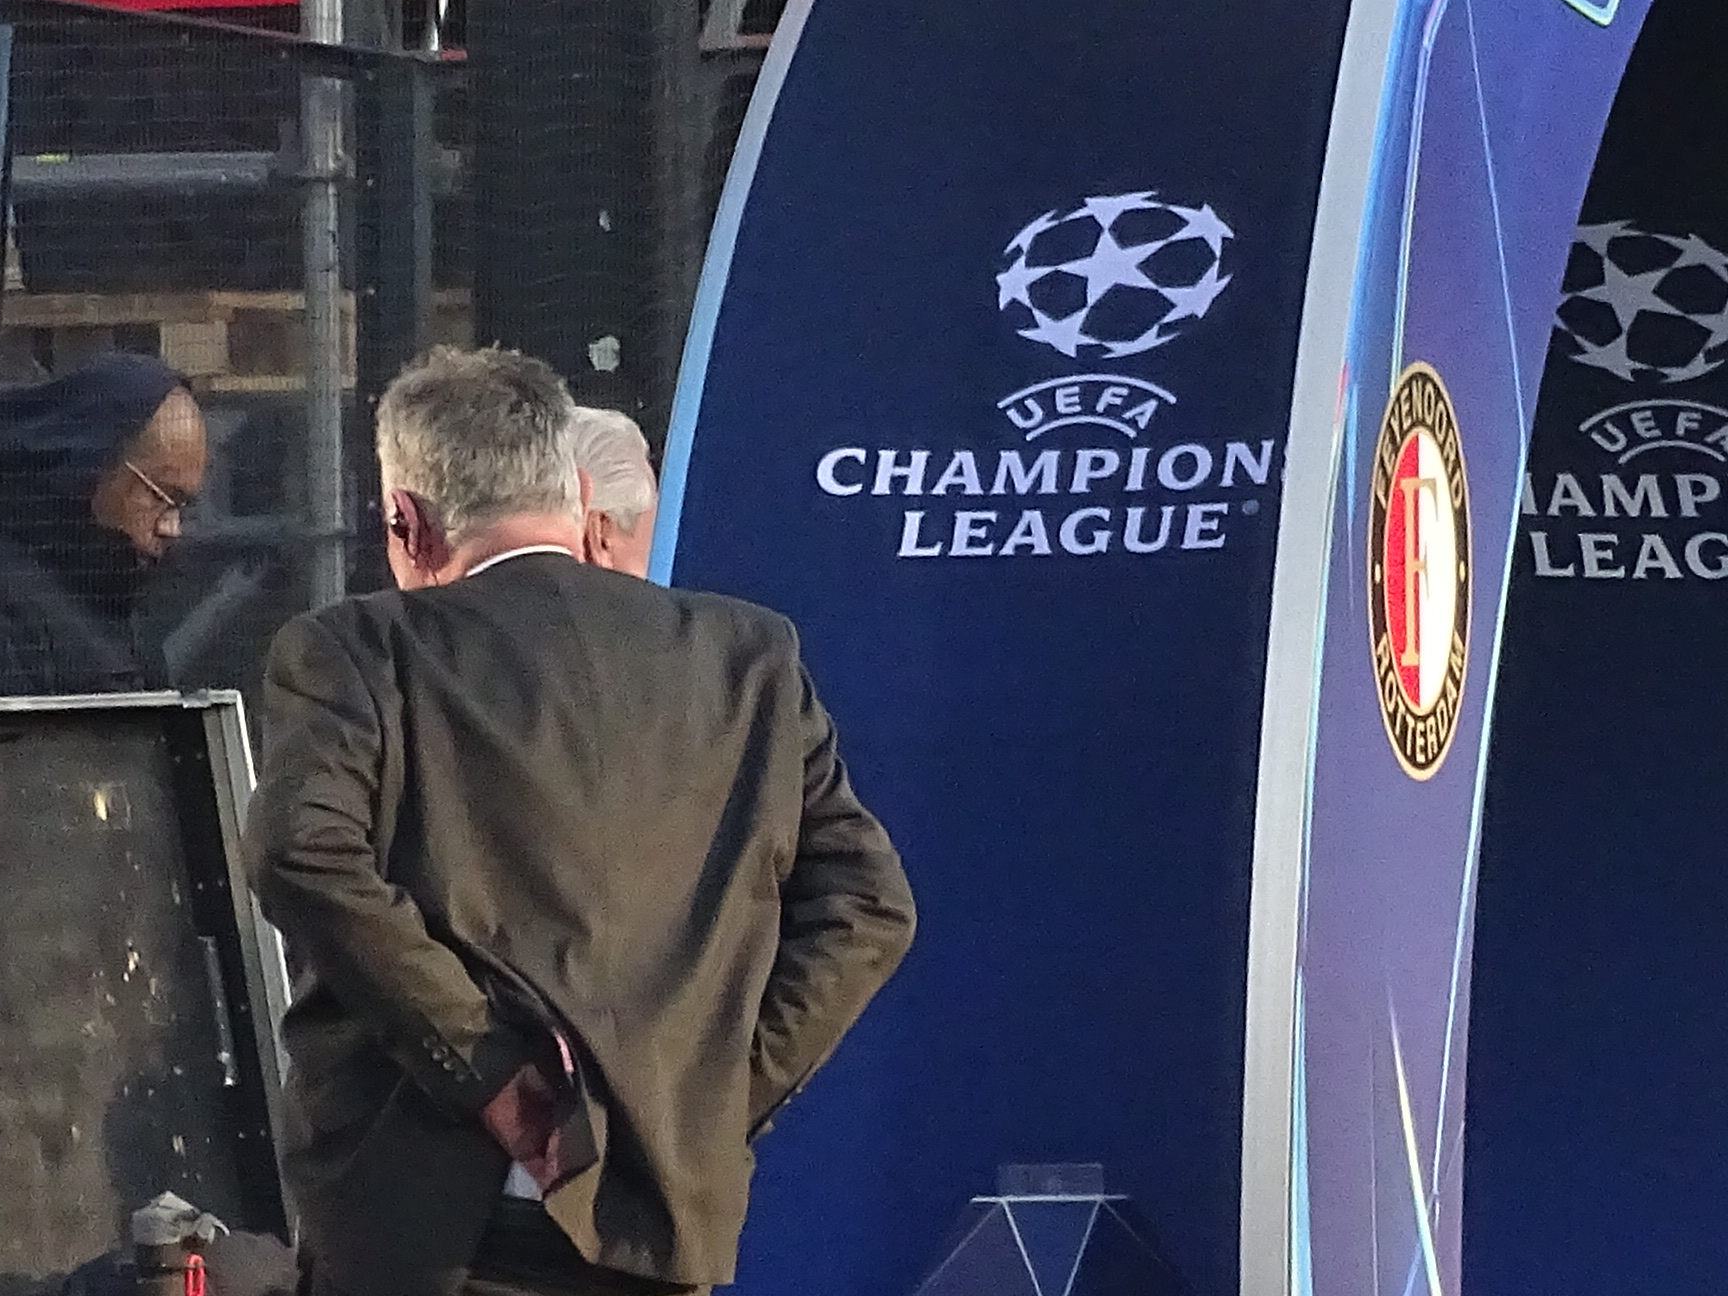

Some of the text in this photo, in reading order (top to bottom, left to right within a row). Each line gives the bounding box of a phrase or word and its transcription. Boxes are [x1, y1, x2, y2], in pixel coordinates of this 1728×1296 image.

[1006, 384, 1160, 431] UEFA
[816, 438, 1284, 497] CHAMPION
[1375, 378, 1464, 510] FEYENOORD
[897, 502, 1229, 559] LEAGUE
[1376, 631, 1466, 764] ROTTERDAM
